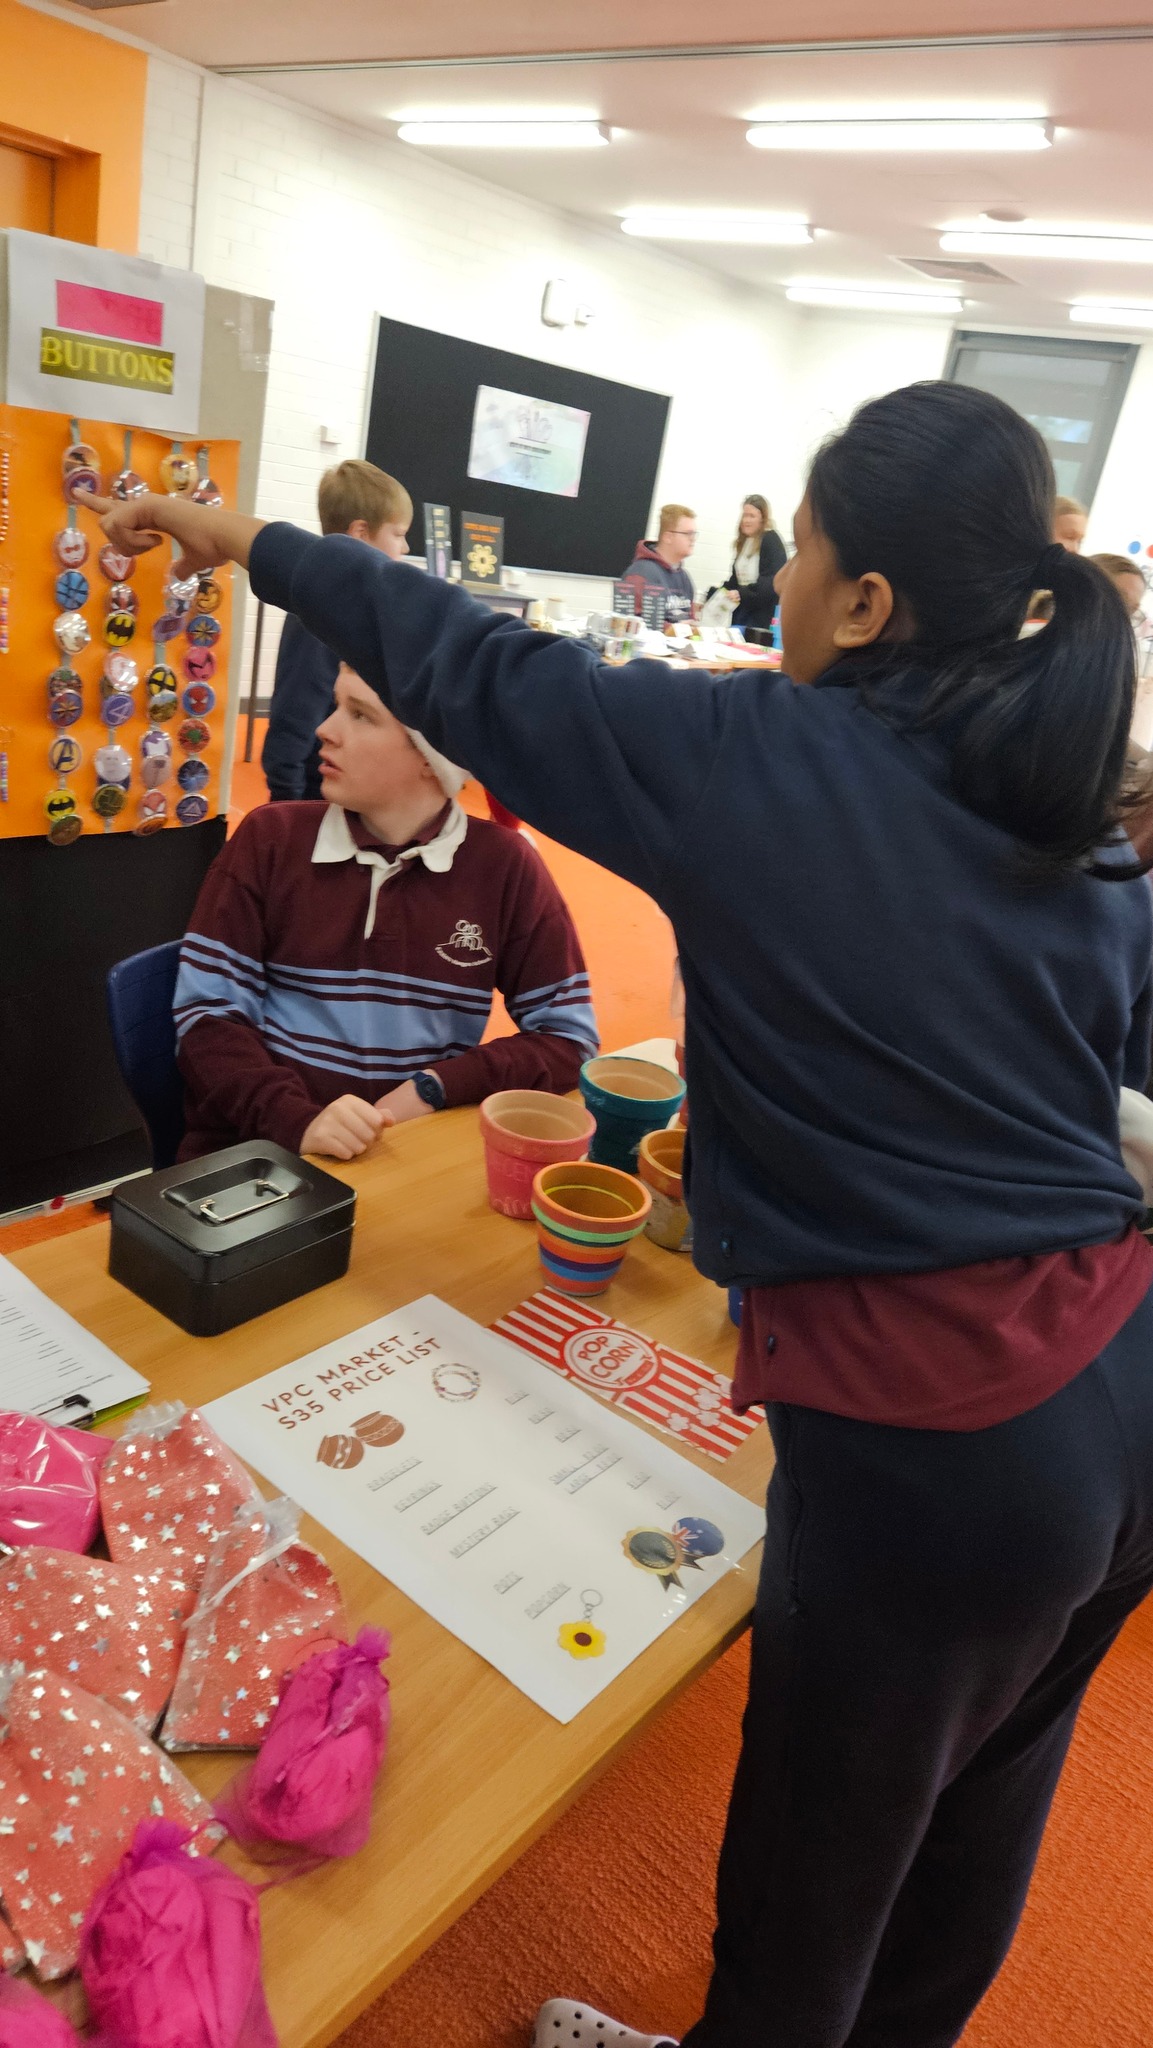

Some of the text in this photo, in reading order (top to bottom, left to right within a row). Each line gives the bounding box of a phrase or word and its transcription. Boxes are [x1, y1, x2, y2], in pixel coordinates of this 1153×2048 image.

[40, 336, 174, 387] BUTTONS
[578, 1336, 609, 1361] POP
[590, 1340, 640, 1378] CORN
[262, 1383, 313, 1412] VPC
[316, 1335, 405, 1384] MARKET
[278, 1337, 441, 1430] S35 PRICE LIST
[524, 1581, 571, 1619] POPCORN
